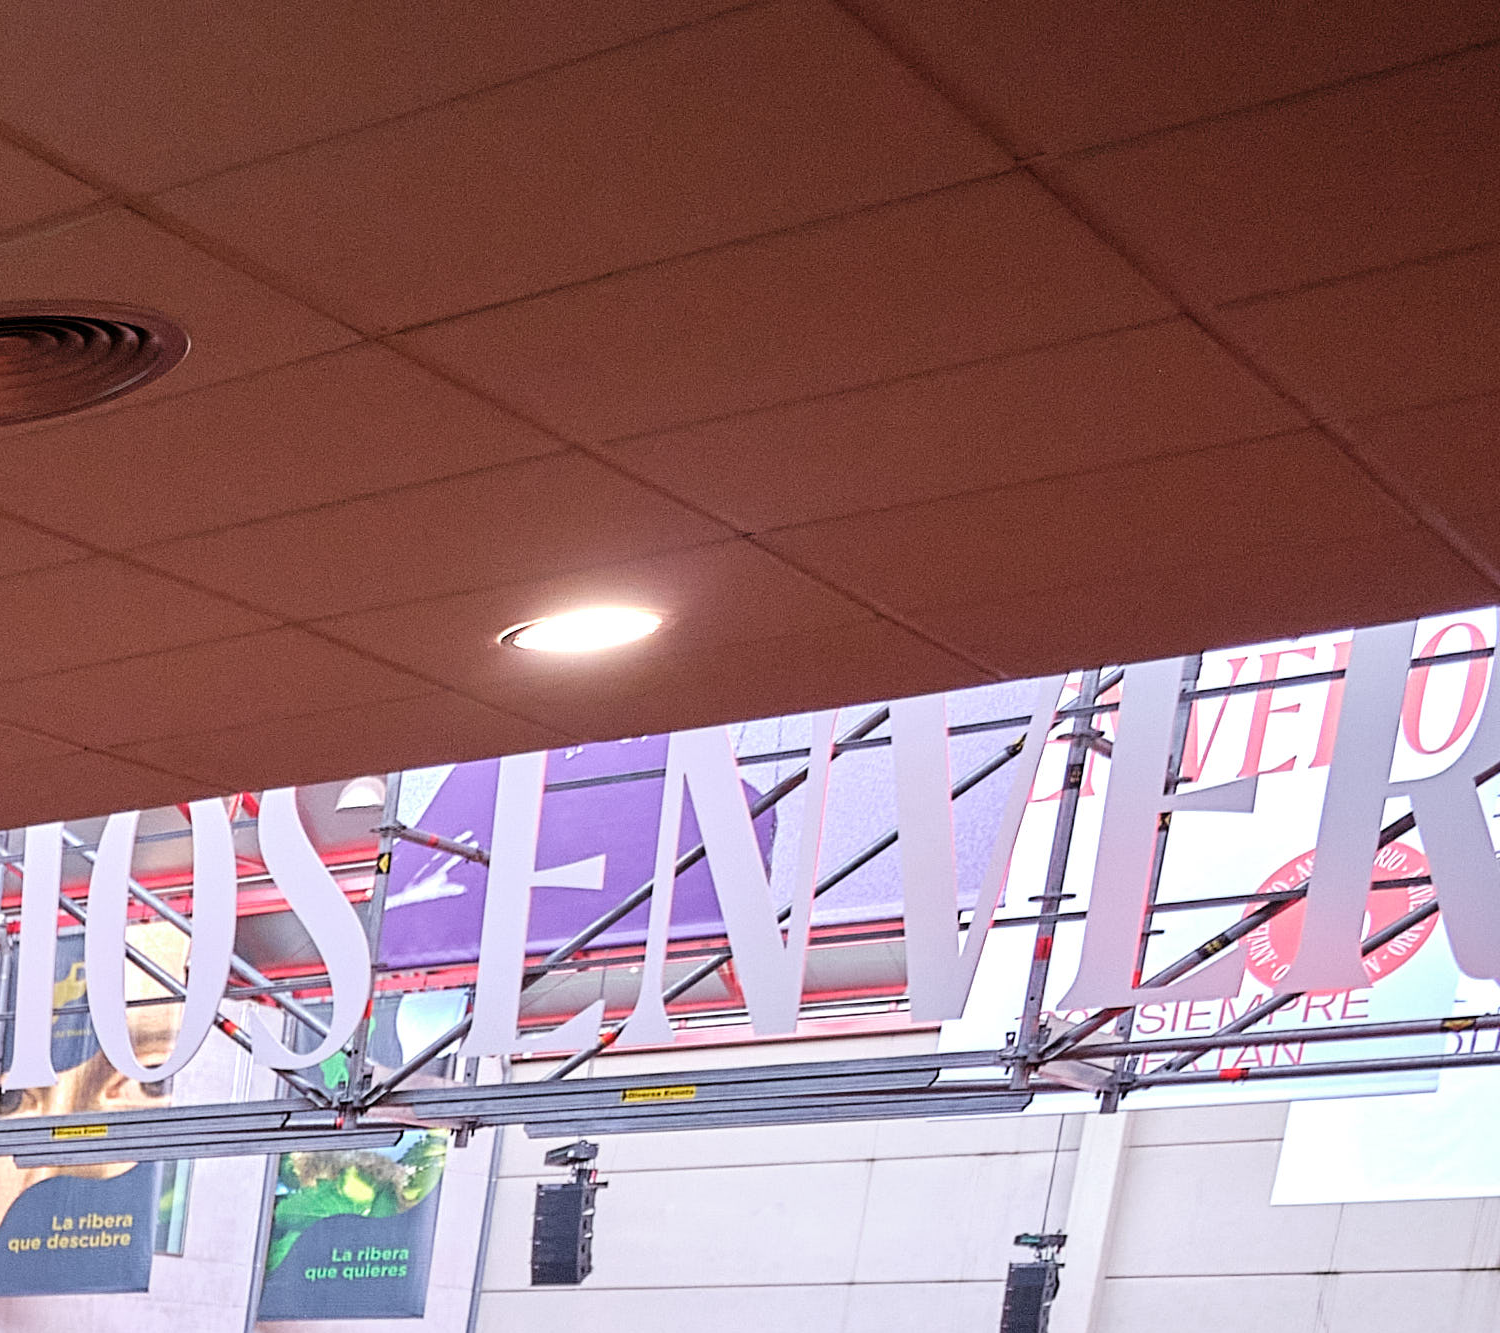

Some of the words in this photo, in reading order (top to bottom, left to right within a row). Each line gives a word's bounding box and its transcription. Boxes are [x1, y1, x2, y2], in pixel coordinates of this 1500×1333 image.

[52, 1215, 74, 1231] La
[78, 1213, 133, 1229] ribera
[8, 1236, 41, 1252] que
[46, 1232, 132, 1250] descubre
[332, 1248, 352, 1262] La
[357, 1246, 409, 1261] ribera
[305, 1265, 338, 1280] que
[342, 1262, 407, 1279] quieres
